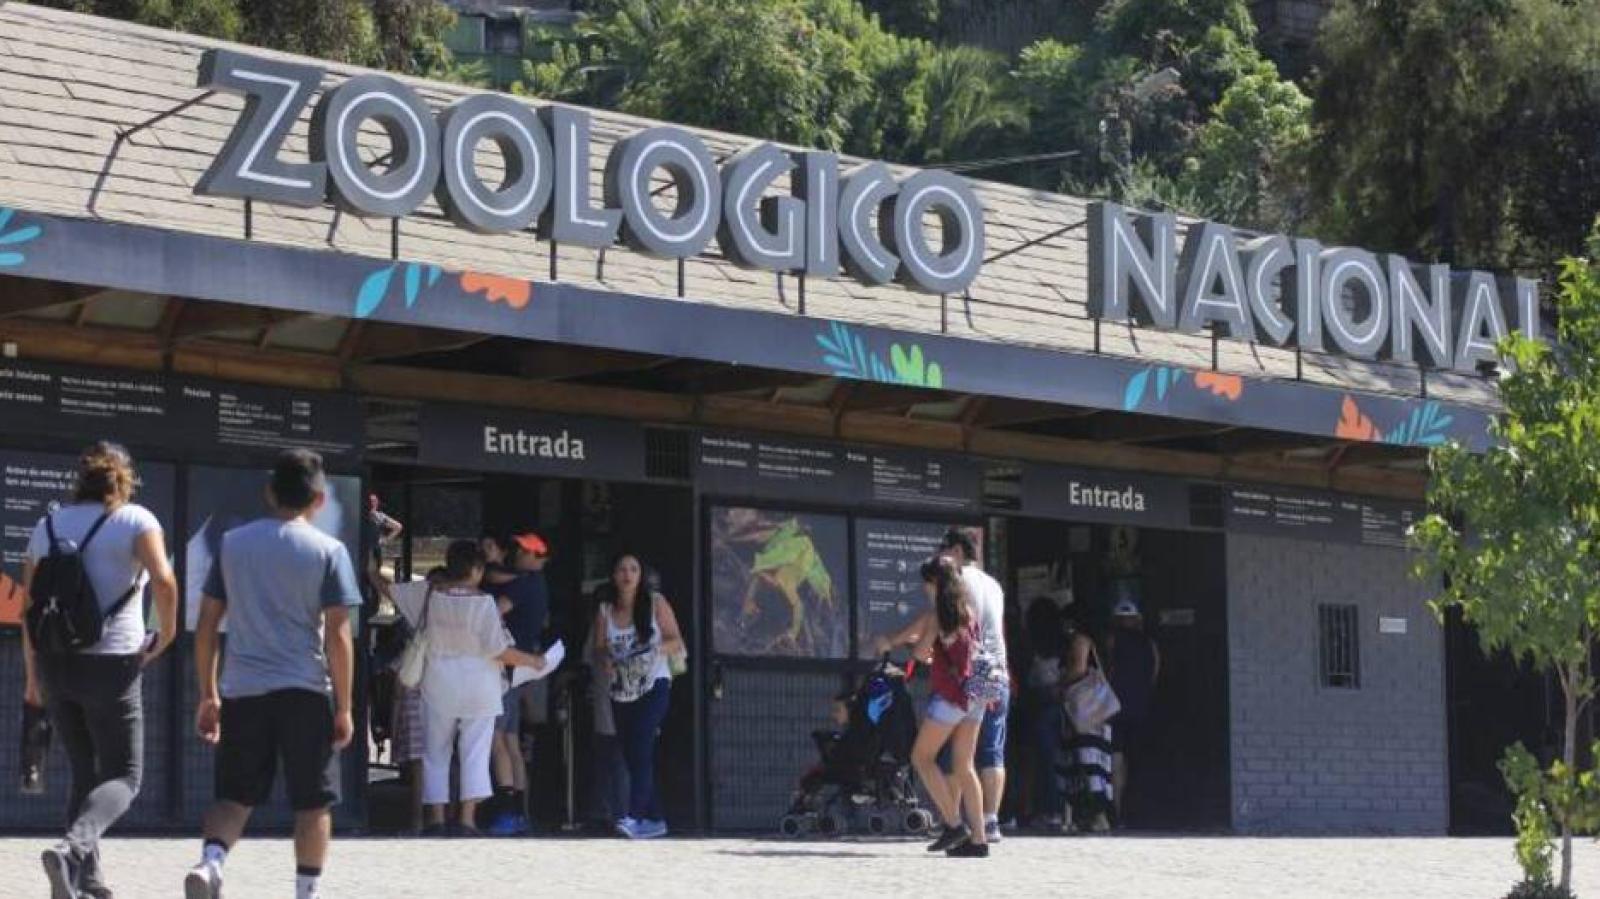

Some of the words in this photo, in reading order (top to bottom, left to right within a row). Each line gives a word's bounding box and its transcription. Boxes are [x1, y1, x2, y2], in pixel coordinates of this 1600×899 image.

[194, 48, 985, 295] ZOOLOGICO
[484, 425, 585, 459] Entrada
[1069, 481, 1145, 511] Entrada
